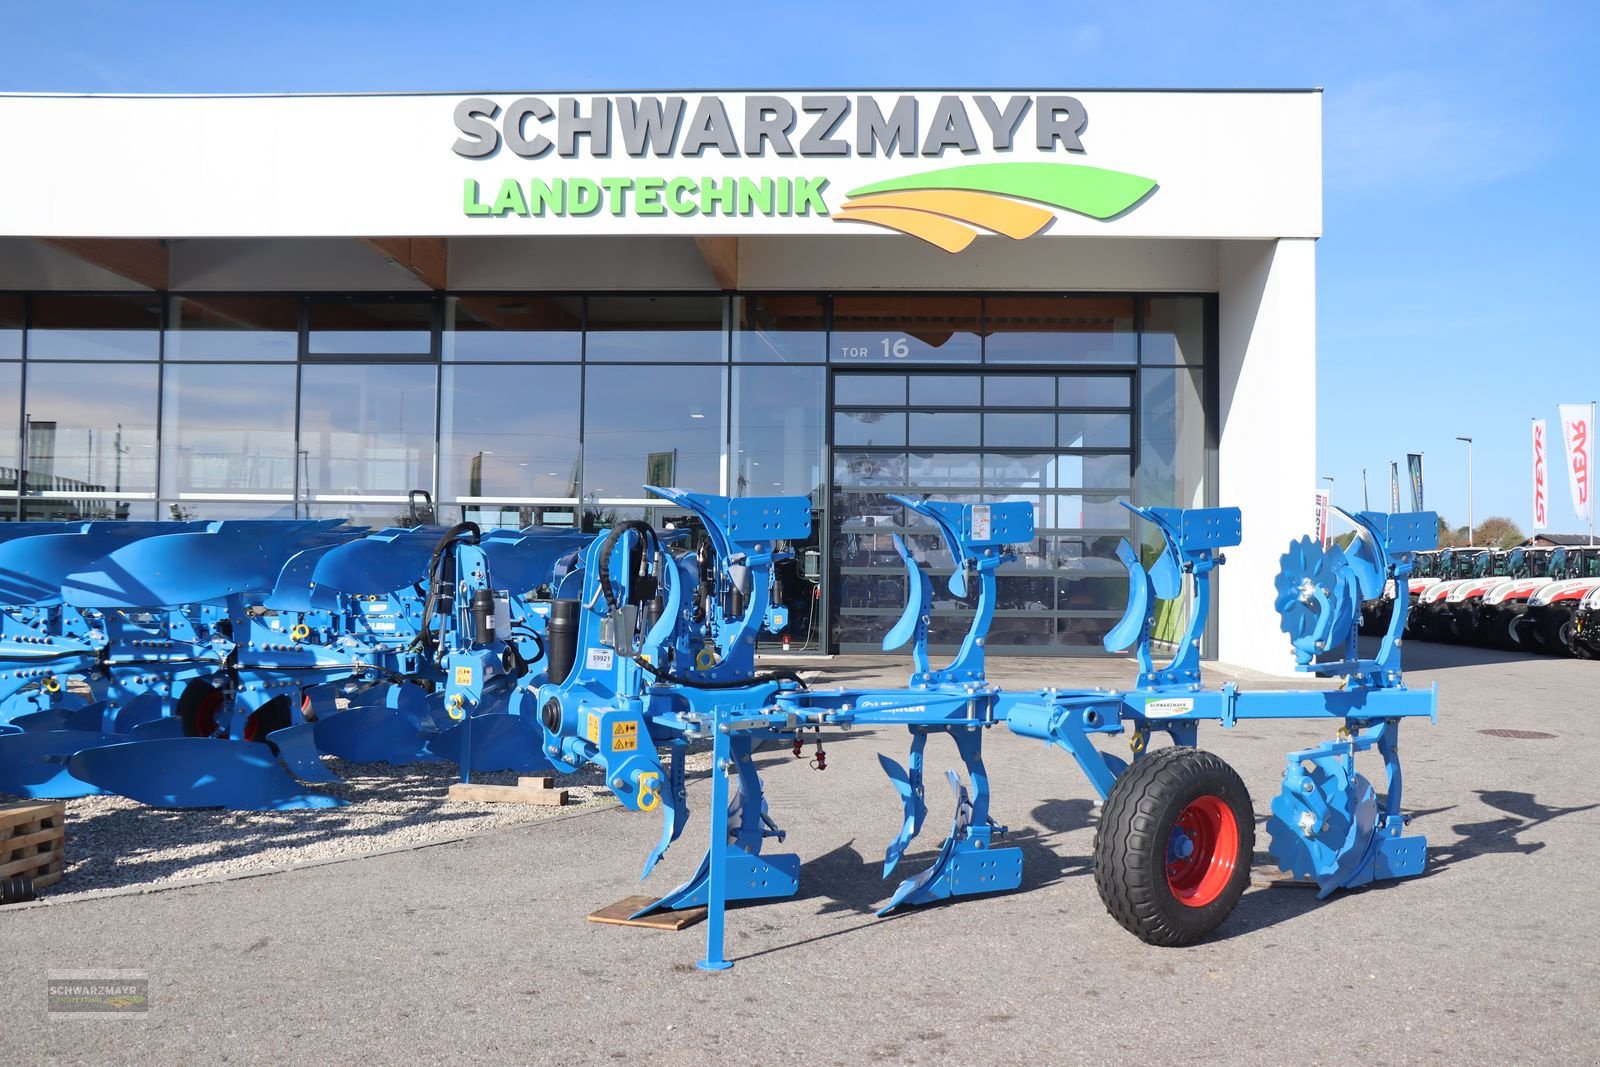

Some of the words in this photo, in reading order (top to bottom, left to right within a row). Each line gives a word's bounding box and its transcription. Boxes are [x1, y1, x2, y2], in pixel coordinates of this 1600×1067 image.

[452, 95, 1088, 158] SCHWARZMAYR
[463, 176, 831, 219] LANDTECHNIK
[841, 348, 868, 357] TOR
[881, 337, 909, 358] 16
[1534, 425, 1545, 526] STEYR
